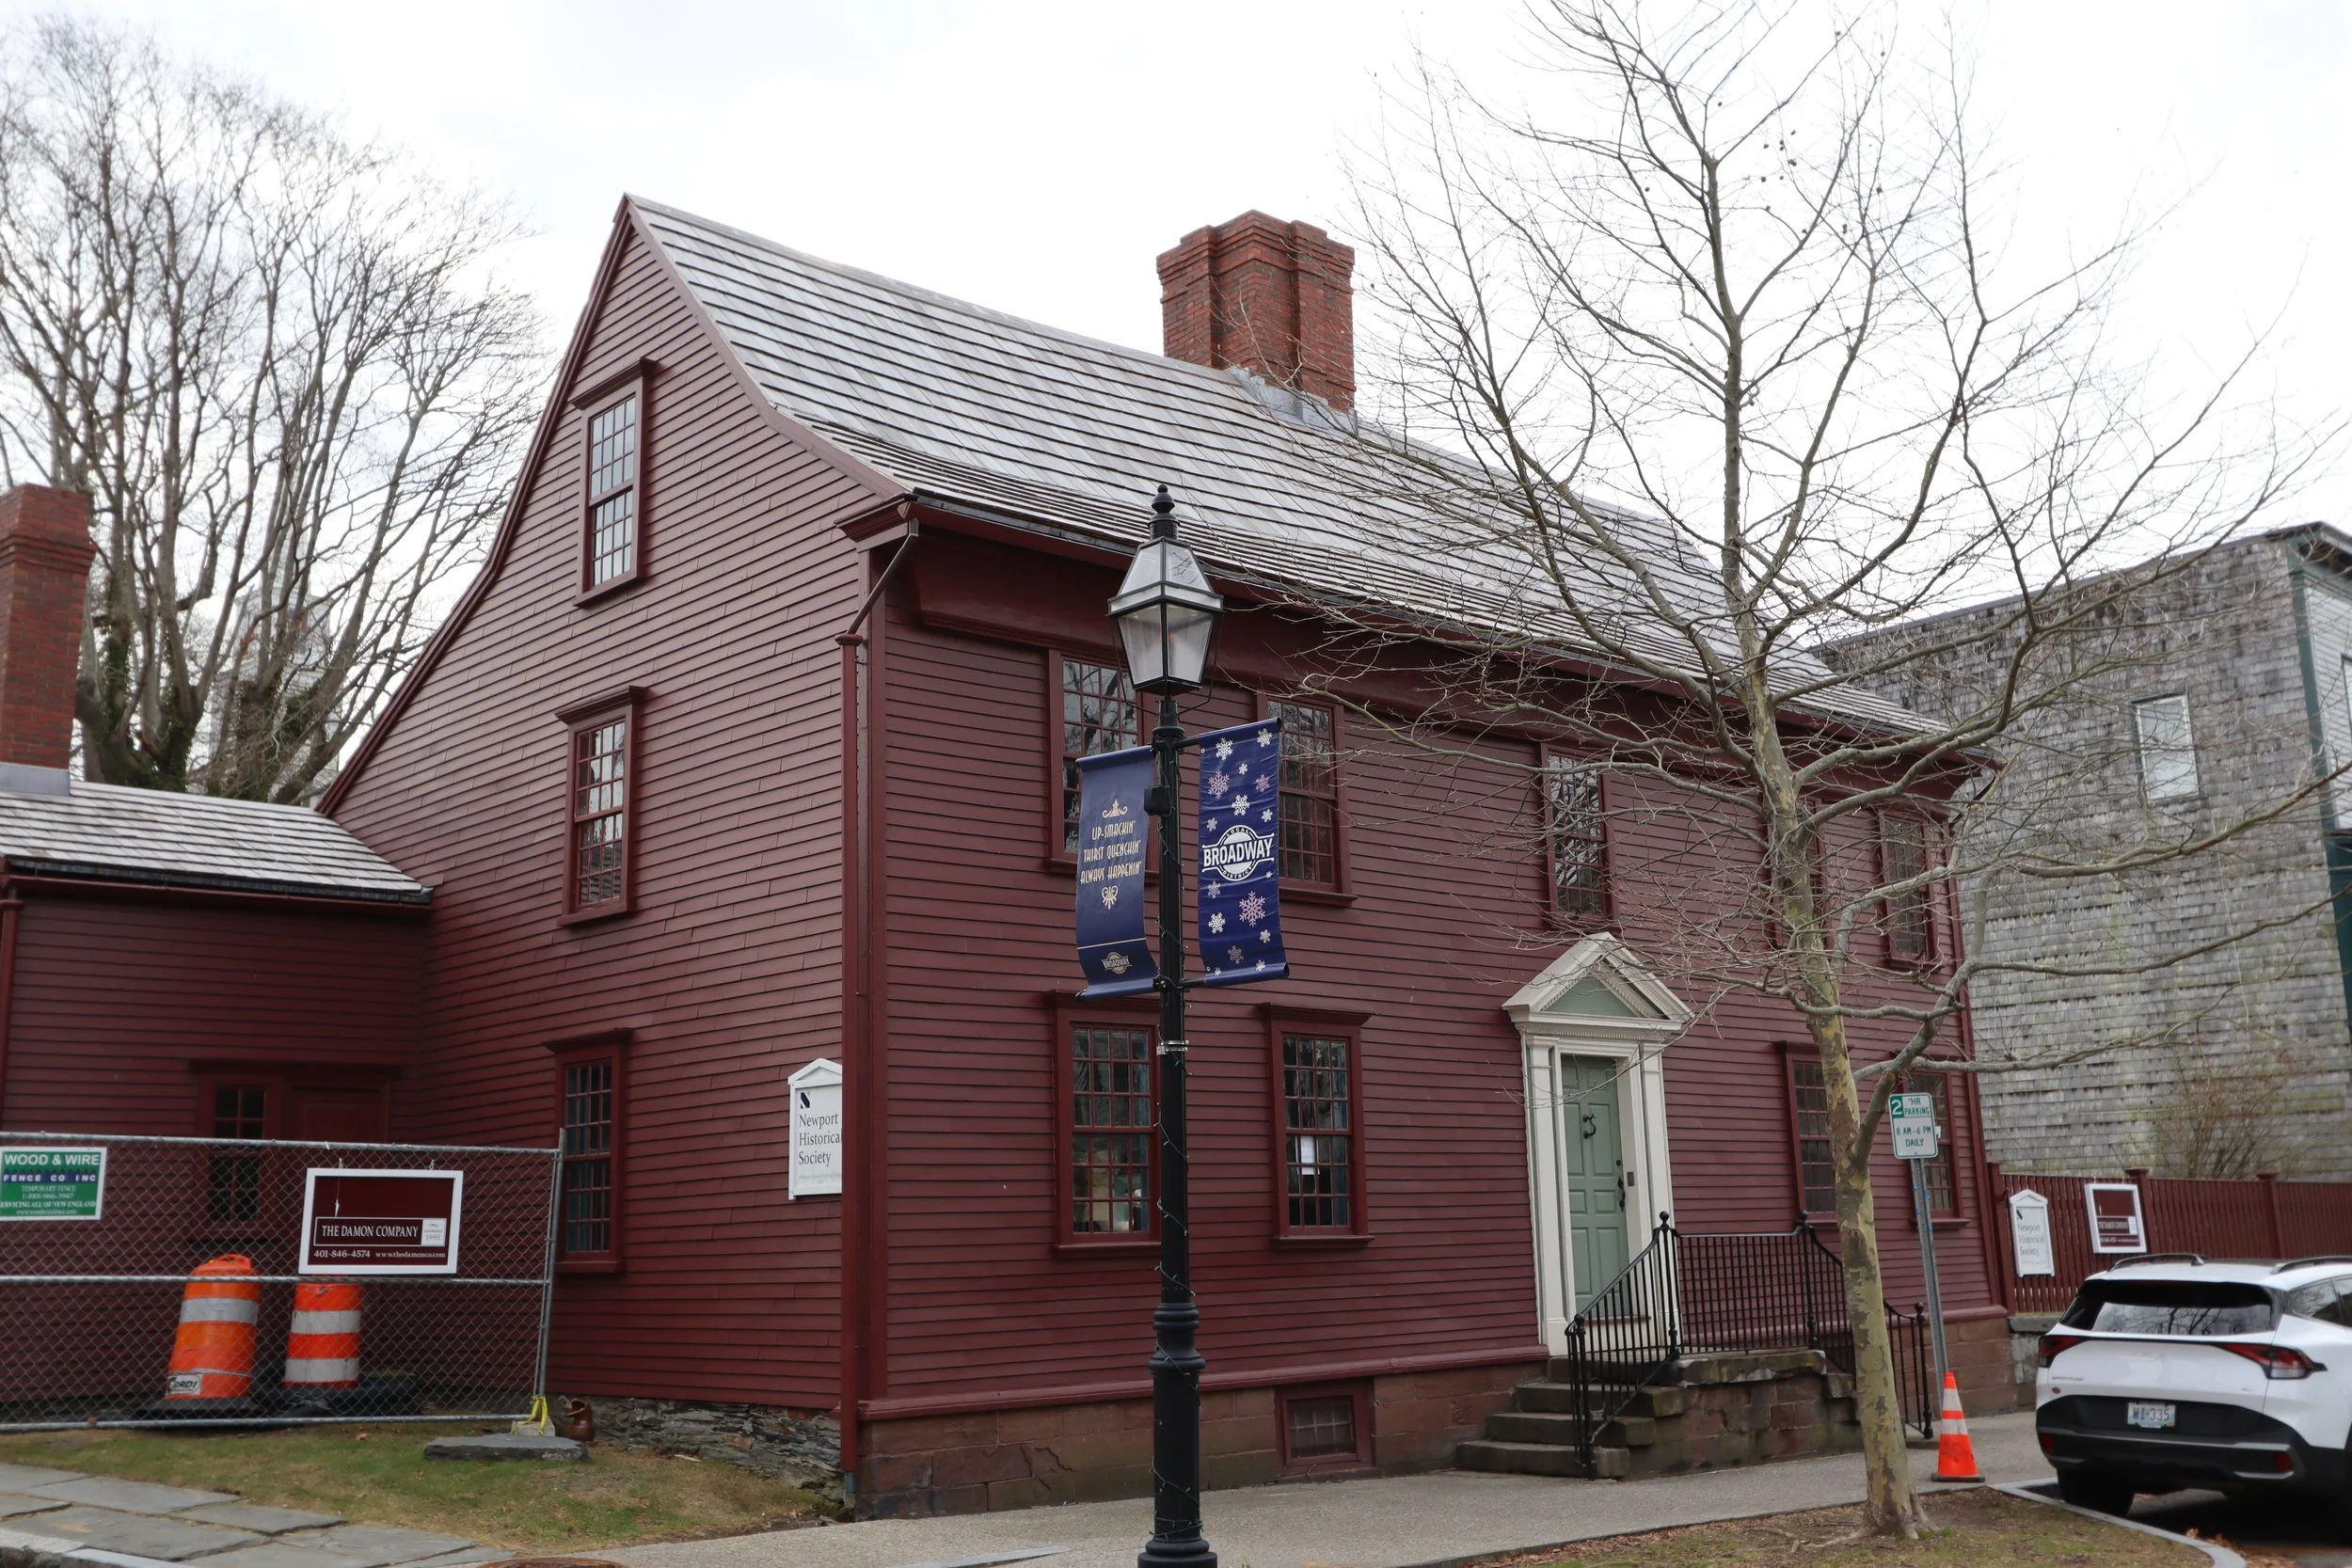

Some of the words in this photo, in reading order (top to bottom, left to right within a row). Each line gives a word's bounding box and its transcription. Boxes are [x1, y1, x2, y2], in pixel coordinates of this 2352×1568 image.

[1091, 820, 1136, 840] LIP-SMACKIN'
[1226, 828, 1249, 837] LOCAL
[1084, 846, 1104, 863] THIRST
[1106, 840, 1141, 860] QUENCHIN'
[1203, 838, 1273, 867] BROADWAY
[1080, 867, 1105, 884] ALWAYS
[1107, 861, 1142, 880] HAPPENIN'
[1222, 866, 1252, 879] DISTRICT
[1891, 1099, 1902, 1115] 2
[1904, 1107, 1931, 1116] PARKING
[799, 1113, 838, 1130] Newport
[1897, 1127, 1900, 1135] 8
[1922, 1125, 1931, 1134] PM
[1905, 1138, 1924, 1147] DAILY
[4, 1154, 48, 1165] WOOD
[52, 1154, 62, 1165] &
[65, 1154, 100, 1165] WIRE
[799, 1150, 832, 1167] Society
[322, 1225, 339, 1237] THE
[342, 1226, 373, 1237] DAMON
[376, 1226, 419, 1238] COMPANY
[2017, 1224, 2041, 1235] Newport
[2018, 1234, 2045, 1243] Historical
[313, 1250, 371, 1259] 401-846-4574
[375, 1250, 446, 1259] www.thedamonco.com
[2020, 1245, 2040, 1257] Society
